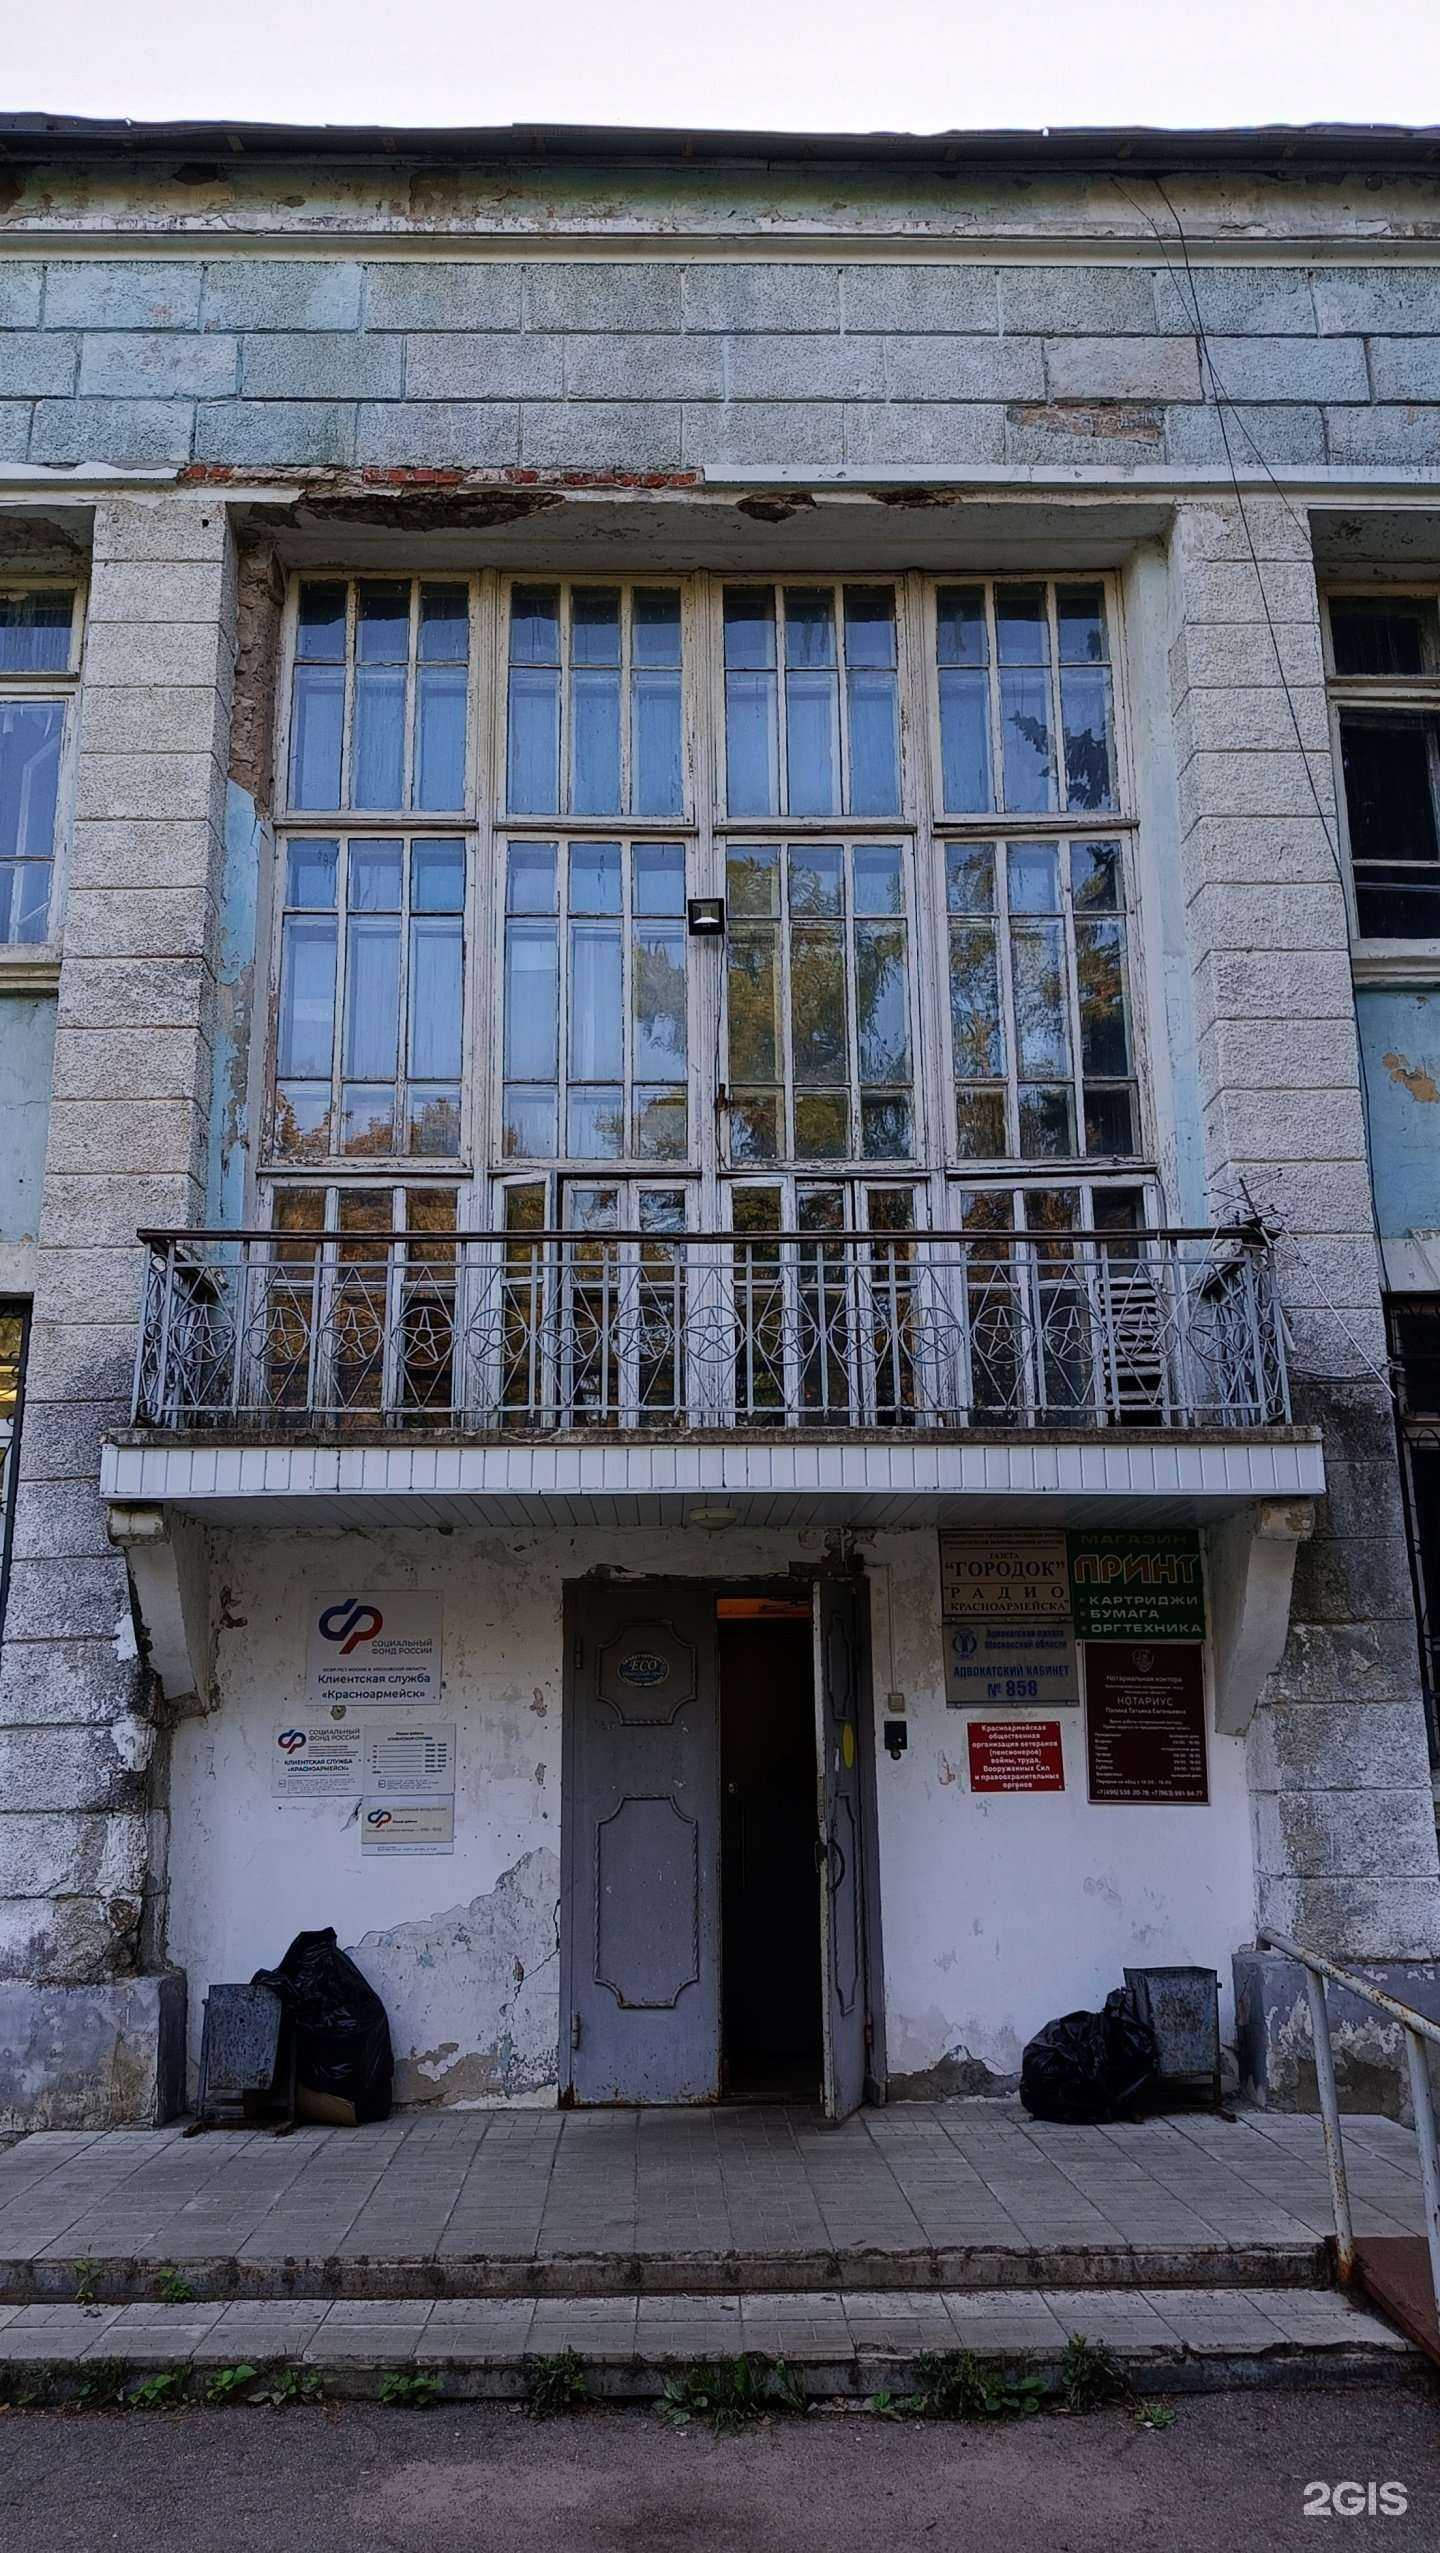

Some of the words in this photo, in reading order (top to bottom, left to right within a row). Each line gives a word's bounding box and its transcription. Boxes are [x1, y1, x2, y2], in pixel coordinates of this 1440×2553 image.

[1080, 1535, 1187, 1545] МАГАЗИН
[1074, 1553, 1200, 1585] ПРИНТ
[1089, 1596, 1198, 1606] КАРТРИДЖИ
[1090, 1609, 1160, 1618] БУМАГА
[1091, 1623, 1202, 1633] ОРГТЕХНИКА
[371, 1638, 433, 1648] СОЦИАЛЬНЫЙ
[371, 1647, 397, 1655] ФОНД
[398, 1647, 433, 1655] РОССИИ
[953, 1664, 1023, 1679] АДВОКАТСКИЙ
[1025, 1664, 1070, 1678] КАБИНЕТ
[318, 1674, 386, 1684] Клиентская
[388, 1672, 431, 1685] служба
[987, 1682, 1002, 1697] №
[1006, 1680, 1038, 1697] 858
[322, 1688, 426, 1701] «Красноармейск»
[1117, 1696, 1174, 1706] НОТАРИУС
[308, 1728, 360, 1736] СОЦИАЛЬНЫЙ
[981, 1725, 1047, 1733] Красноармейская
[331, 1734, 360, 1742] РОССИИ
[989, 1748, 1042, 1757] (пенсионеров)
[990, 1757, 1017, 1765] войны,
[1036, 1764, 1051, 1772] Сил
[980, 1773, 1060, 1782] правоохранительных
[1002, 1782, 1033, 1790] органов
